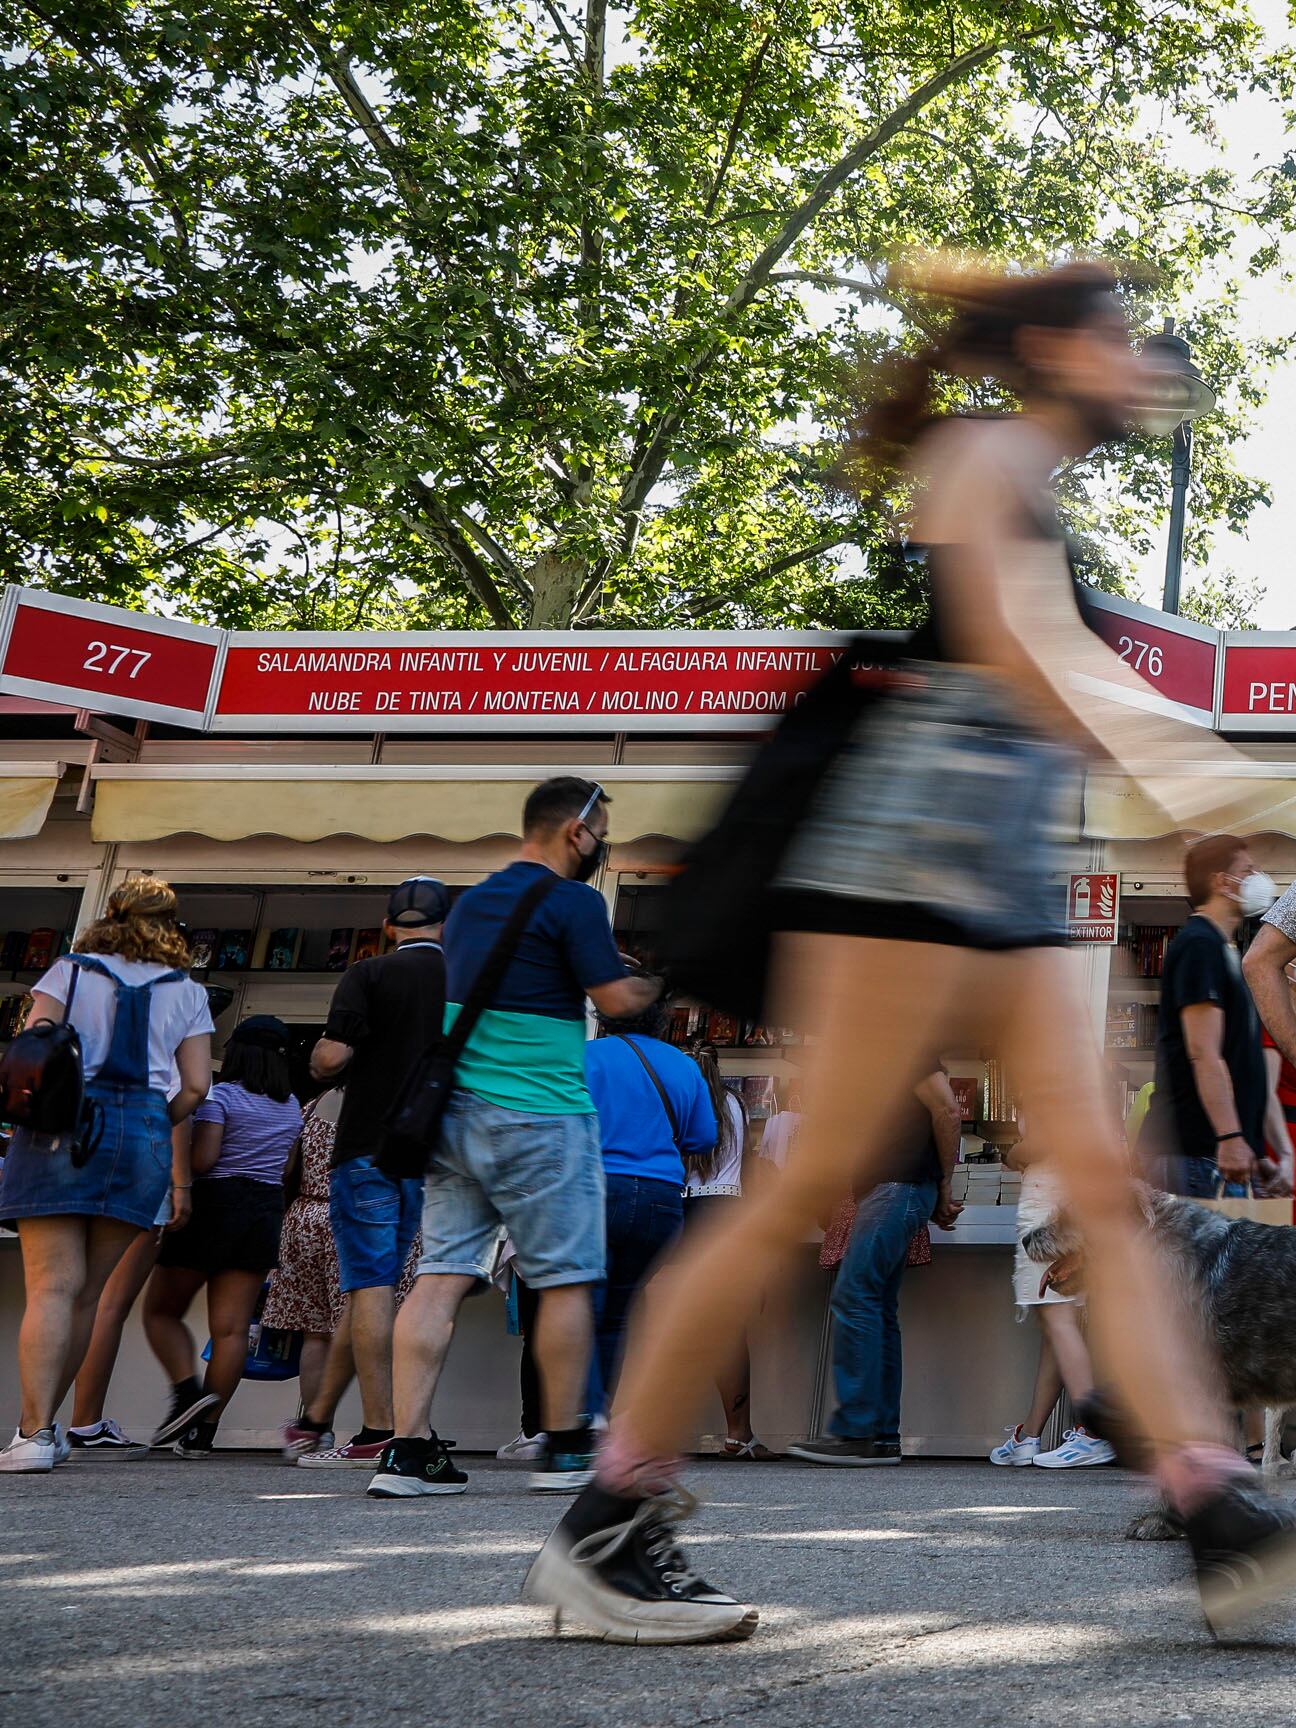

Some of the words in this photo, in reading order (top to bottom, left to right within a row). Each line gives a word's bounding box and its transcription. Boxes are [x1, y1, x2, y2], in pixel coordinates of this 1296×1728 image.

[82, 640, 152, 679] 277
[256, 651, 393, 673] SALAMANDRA
[398, 651, 484, 673] INFANTIL
[492, 651, 508, 672] Y
[510, 651, 594, 673] JUVENIL
[599, 651, 611, 672] /
[614, 651, 728, 672] ALFAGUARA
[735, 651, 821, 671] INFANTIL
[1116, 634, 1164, 679] 276
[307, 690, 362, 711] NUBE
[375, 690, 401, 711] DE
[408, 690, 461, 711] TINTA
[467, 690, 480, 711] /
[482, 690, 580, 711] MONTENA
[585, 690, 597, 711] /
[600, 690, 680, 711] MOLINO
[683, 690, 696, 711] /
[698, 690, 786, 710] RANDOM
[1070, 926, 1113, 938] EXTINTOR
